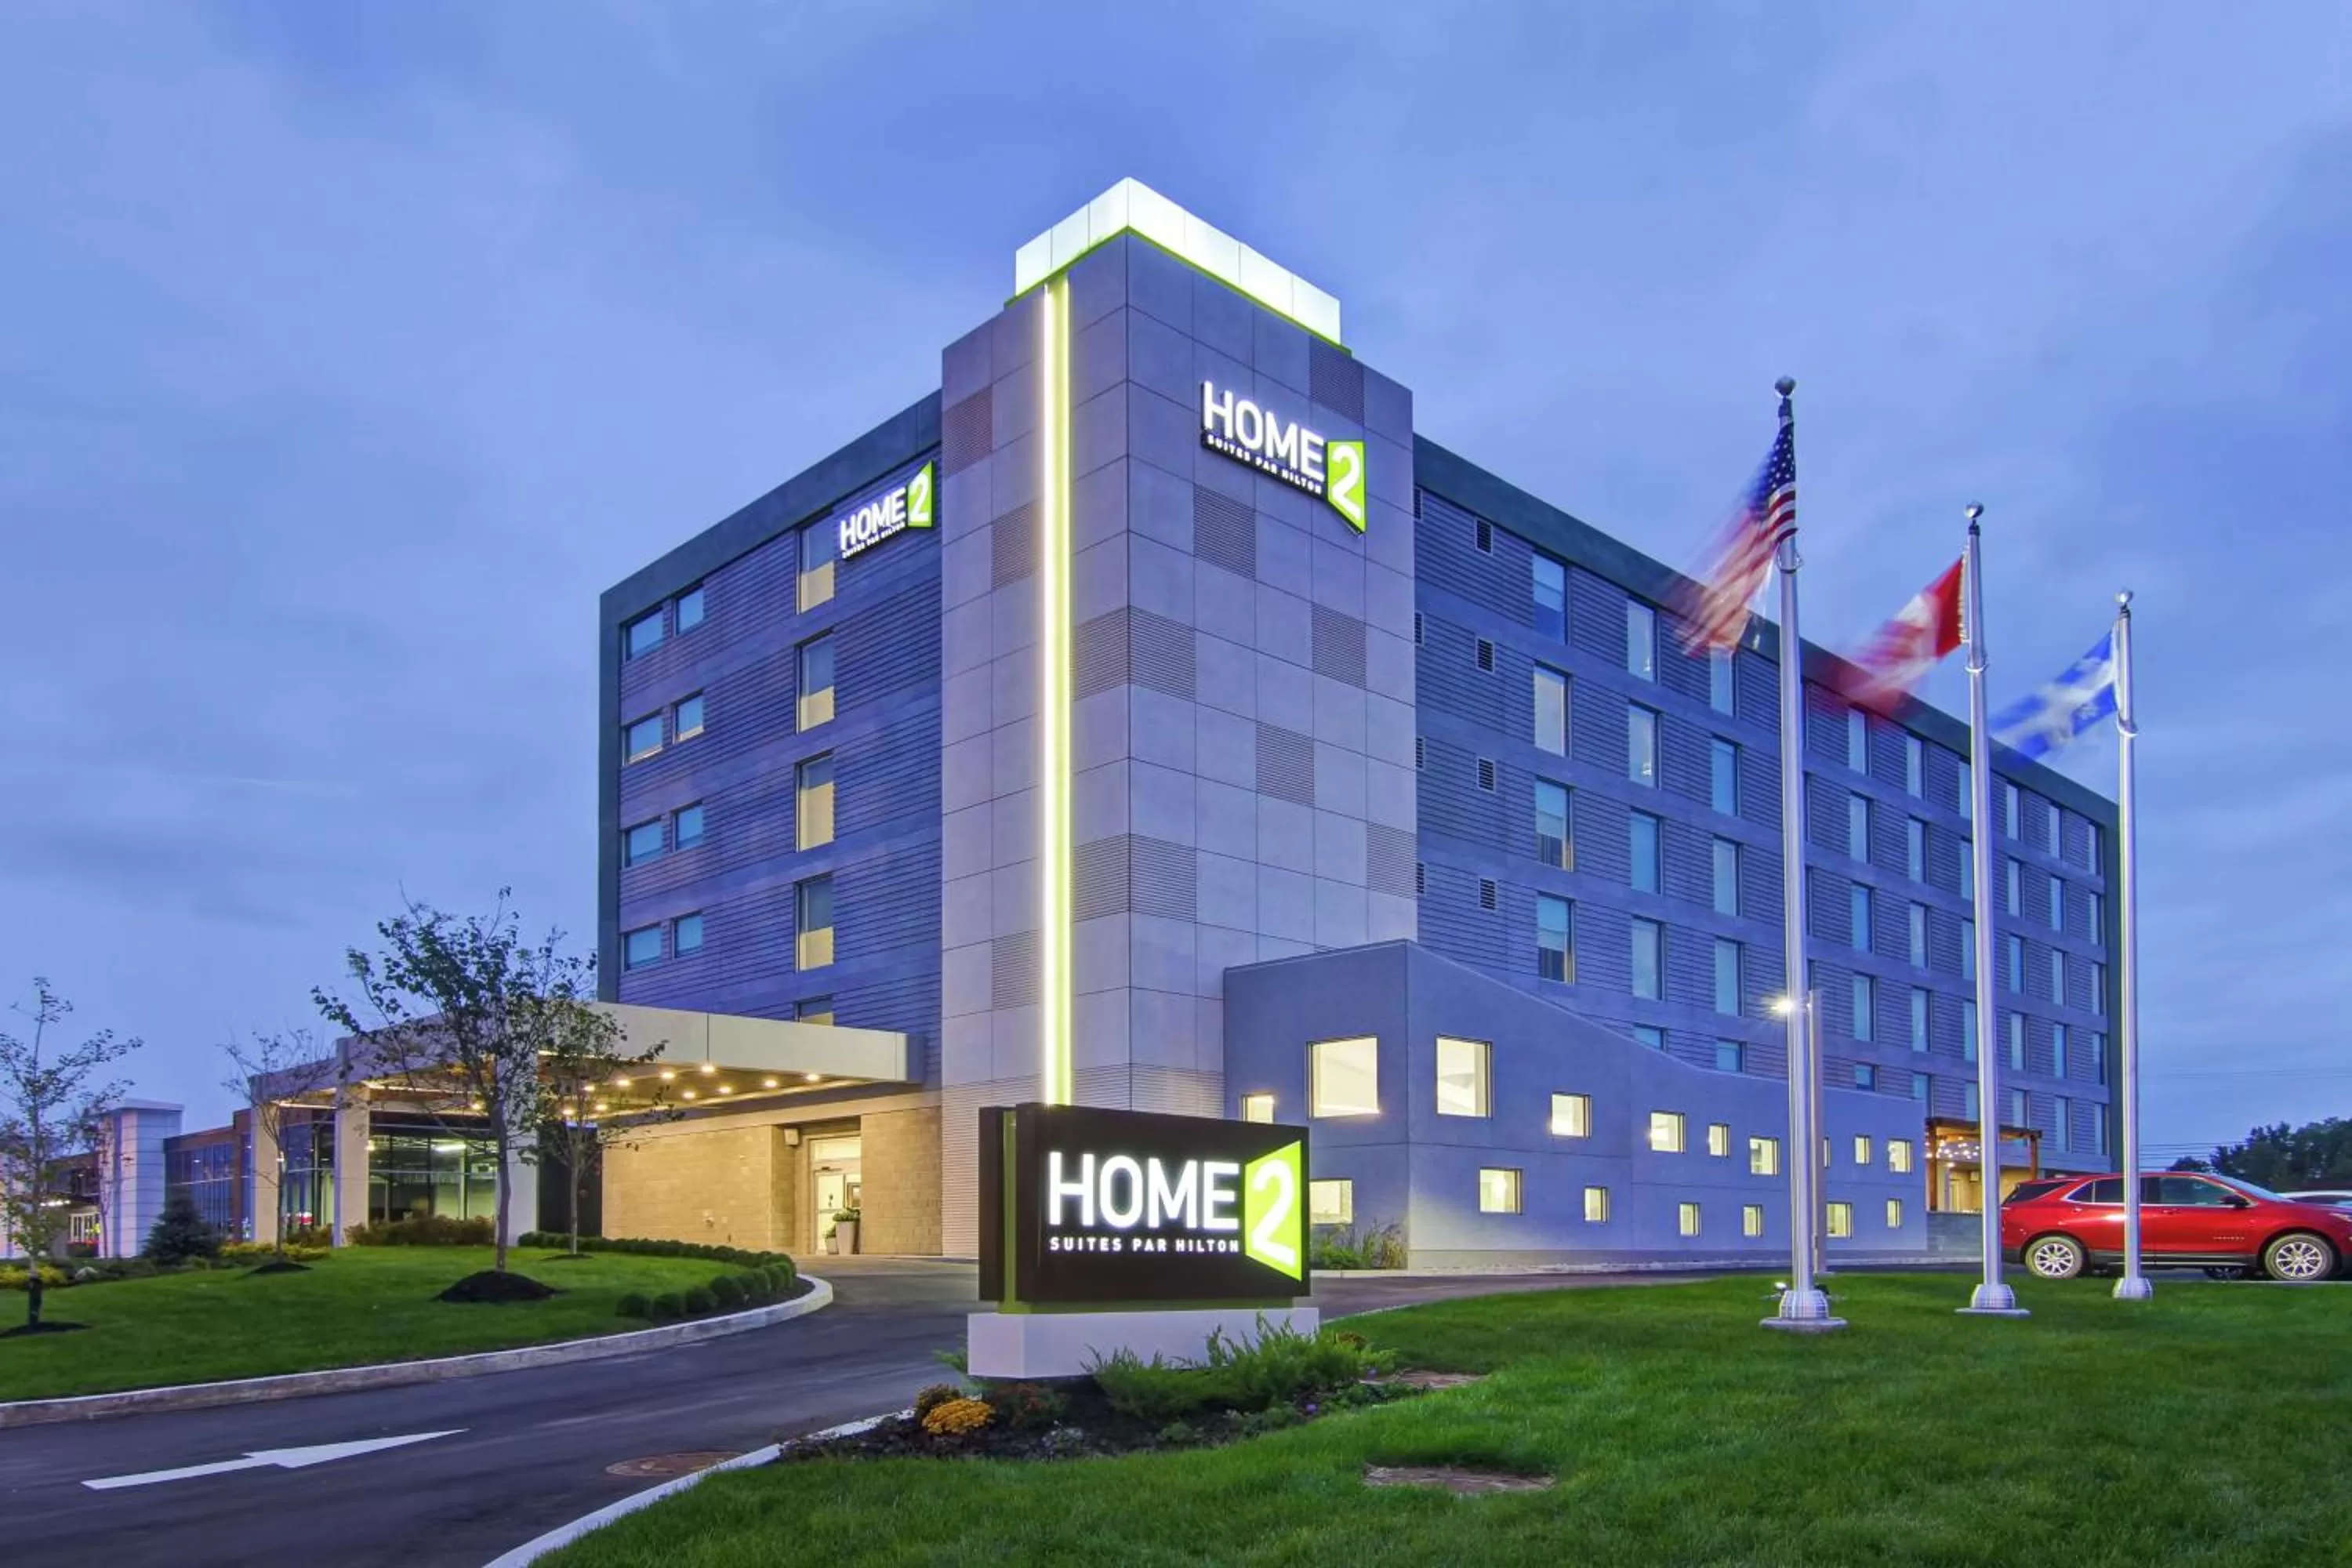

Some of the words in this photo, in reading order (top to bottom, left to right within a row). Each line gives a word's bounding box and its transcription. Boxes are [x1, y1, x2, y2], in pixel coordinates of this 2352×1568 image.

[1207, 434, 1251, 463] SUITES
[1255, 456, 1278, 475] PAR
[1281, 467, 1323, 495] HILTON
[1049, 1236, 1123, 1252] SUITES
[1132, 1237, 1167, 1253] PAR
[1175, 1238, 1240, 1253] HILTON
